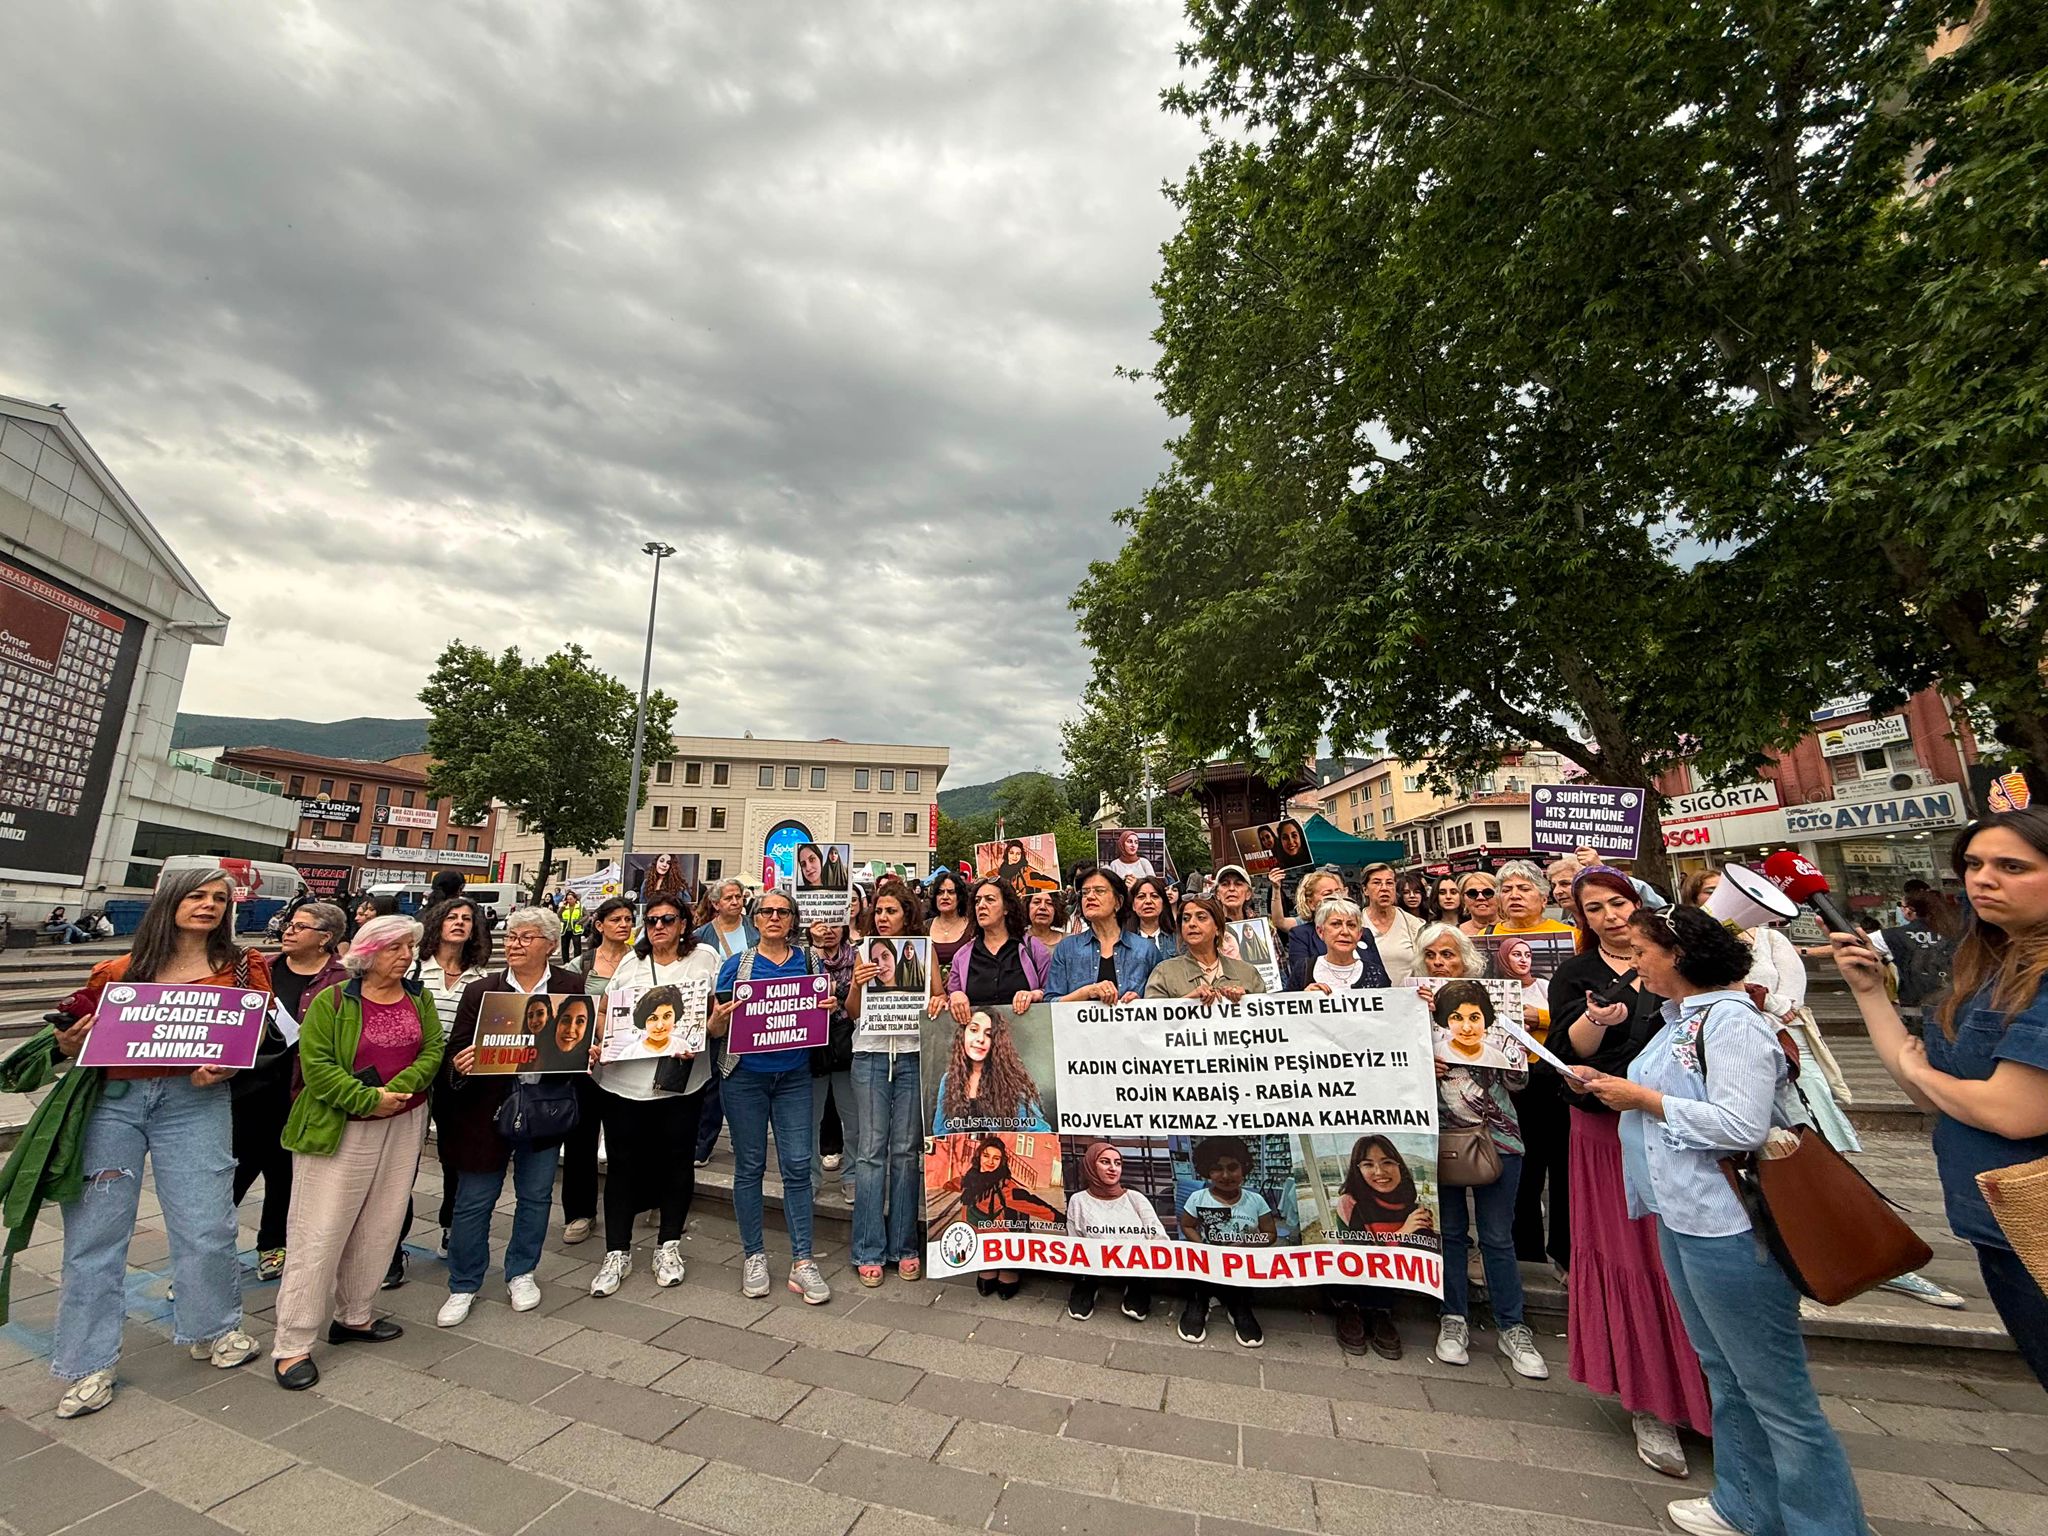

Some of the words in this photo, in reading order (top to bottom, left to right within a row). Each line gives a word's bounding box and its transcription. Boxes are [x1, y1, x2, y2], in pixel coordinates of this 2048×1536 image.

[0, 629, 31, 650] Ömer
[1556, 790, 1616, 806] SURİYE'DE
[320, 802, 361, 813] TURİZM
[1545, 806, 1566, 819] HTŞ
[1568, 807, 1625, 822] ZULMÜNE
[1786, 813, 1833, 830] FOTO
[1835, 794, 1952, 829] AYHAN
[1535, 819, 1568, 829] DİRENEN
[1569, 821, 1593, 831] ALEVİ
[1594, 823, 1634, 834] KADINLAR
[1535, 832, 1574, 846] YALNIZ
[766, 982, 801, 998] KADIN
[158, 990, 221, 1007] KADIN
[745, 994, 817, 1016] MÜCADELESİ
[119, 1004, 246, 1026] MÜCADELESİ
[1077, 1004, 1157, 1022] GÜLİSTAN
[1163, 1004, 1212, 1021] DOKU
[1217, 1003, 1242, 1018] VE
[1246, 999, 1314, 1017] SİSTEM
[1319, 994, 1384, 1013] ELİYLE
[765, 1014, 797, 1030] SINIR
[151, 1024, 209, 1040] SINIR
[752, 1028, 808, 1046] TANIMAZ!
[1165, 1028, 1208, 1047] FAİLİ
[1214, 1027, 1289, 1048] MEÇHUL
[482, 1034, 535, 1047] ROJVELAT'A
[126, 1042, 224, 1058] TANIMAZ!
[480, 1047, 496, 1065] NE
[498, 1047, 538, 1064] OLDU?
[1067, 1060, 1117, 1075] KADIN
[1122, 1053, 1269, 1075] CİNAYETLERİNİN
[1274, 1048, 1386, 1074] PEŞİNDEYİZ
[1390, 1051, 1409, 1067] !!!
[1115, 1083, 1167, 1102] ROJİN
[1173, 1082, 1240, 1105] KABAİŞ
[1256, 1079, 1313, 1100] RABİA
[1317, 1081, 1357, 1098] NAZ
[944, 1115, 1002, 1130] GÜLİSTAN
[1004, 1117, 1037, 1128] DOKU
[1060, 1113, 1144, 1129] ROJVELAT
[1149, 1114, 1218, 1130] KIZMAZ
[1319, 1110, 1431, 1127] KAHARMAN
[977, 1219, 1027, 1230] ROJVELAT
[1028, 1221, 1066, 1232] KIZMAZ
[1086, 1224, 1116, 1235] ROJİN
[1118, 1225, 1157, 1236] KABAİŞ
[1208, 1229, 1243, 1243] RABİA
[1244, 1232, 1270, 1244] NAZ
[1320, 1230, 1375, 1241] YELDANA
[1376, 1231, 1438, 1249] KAHARMAN
[983, 1238, 1090, 1268] BURSA
[1101, 1245, 1210, 1275] KADIN
[1222, 1251, 1441, 1289] PLATFORMU
